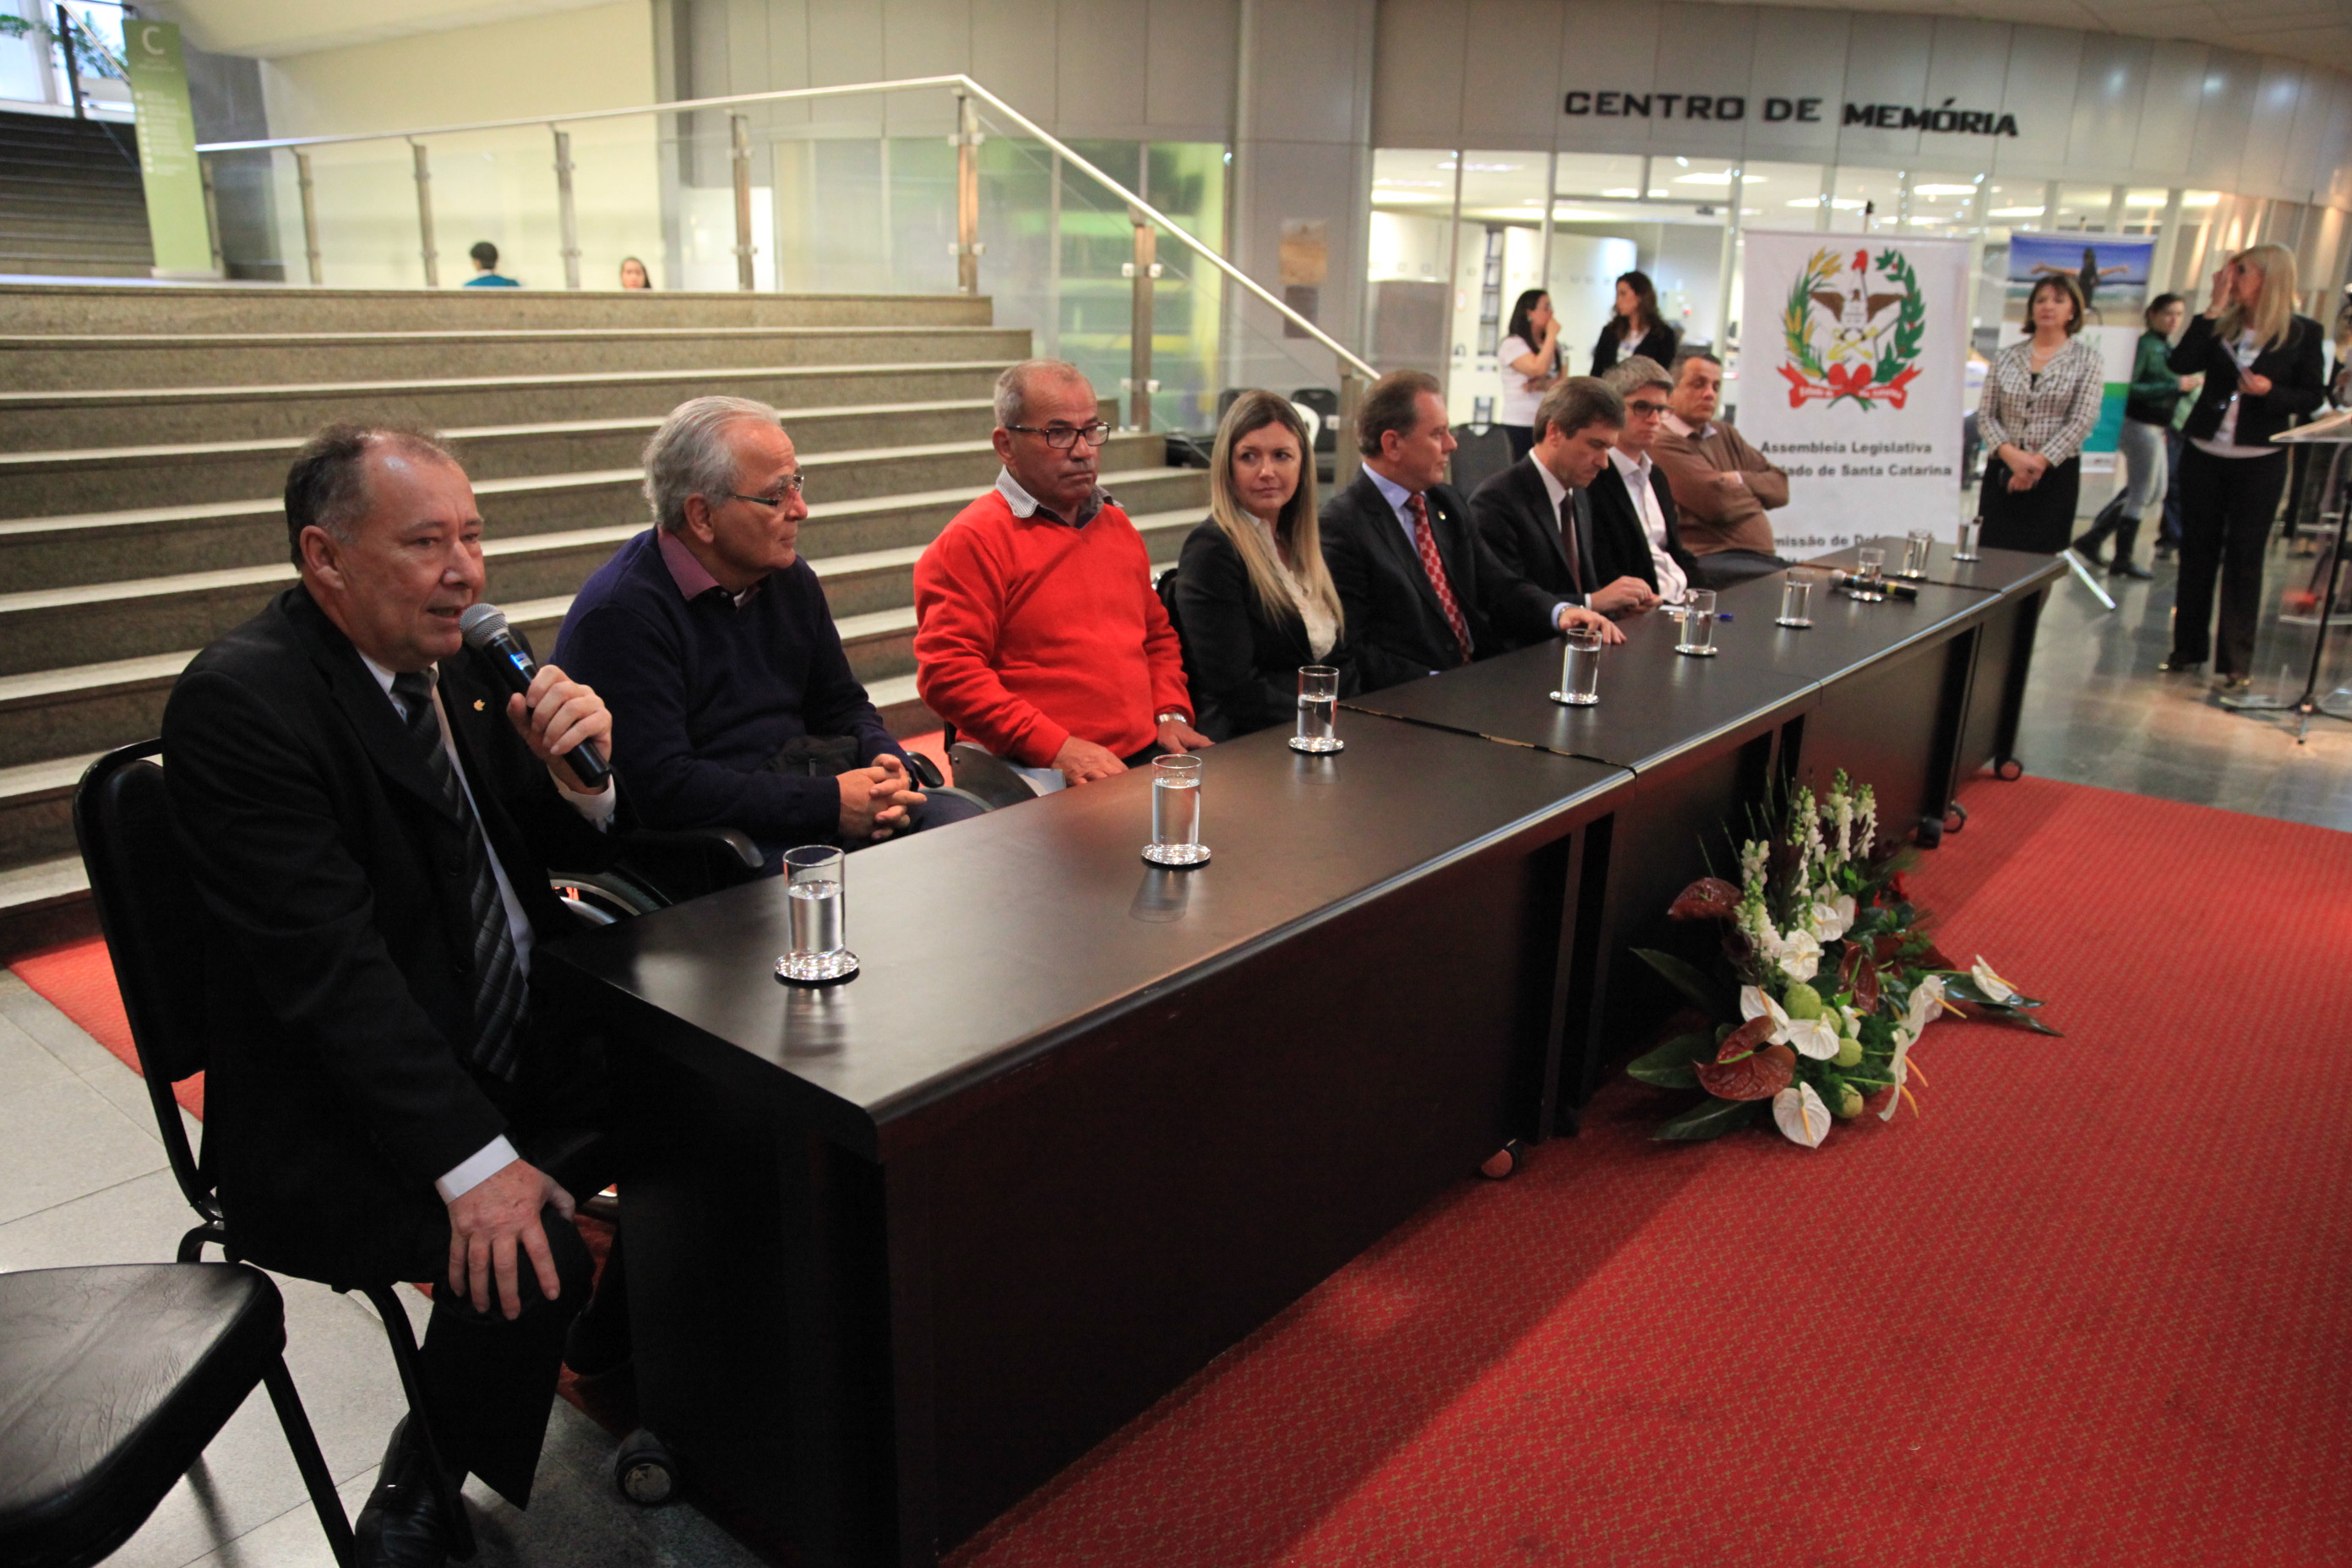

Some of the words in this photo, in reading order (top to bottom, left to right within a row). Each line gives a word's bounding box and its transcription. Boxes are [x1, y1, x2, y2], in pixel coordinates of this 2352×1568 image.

[142, 26, 165, 55] C
[1564, 90, 1745, 122] CENTRO
[1763, 97, 1822, 122] DE
[1843, 97, 2019, 137] MEMÓRIA
[1761, 442, 1846, 454] Assembleia
[1852, 442, 1932, 456] Legislativa
[1818, 465, 1836, 476] de
[1842, 465, 1884, 476] Santa
[1888, 465, 1952, 476] Catarina
[1831, 535, 1848, 546] de
